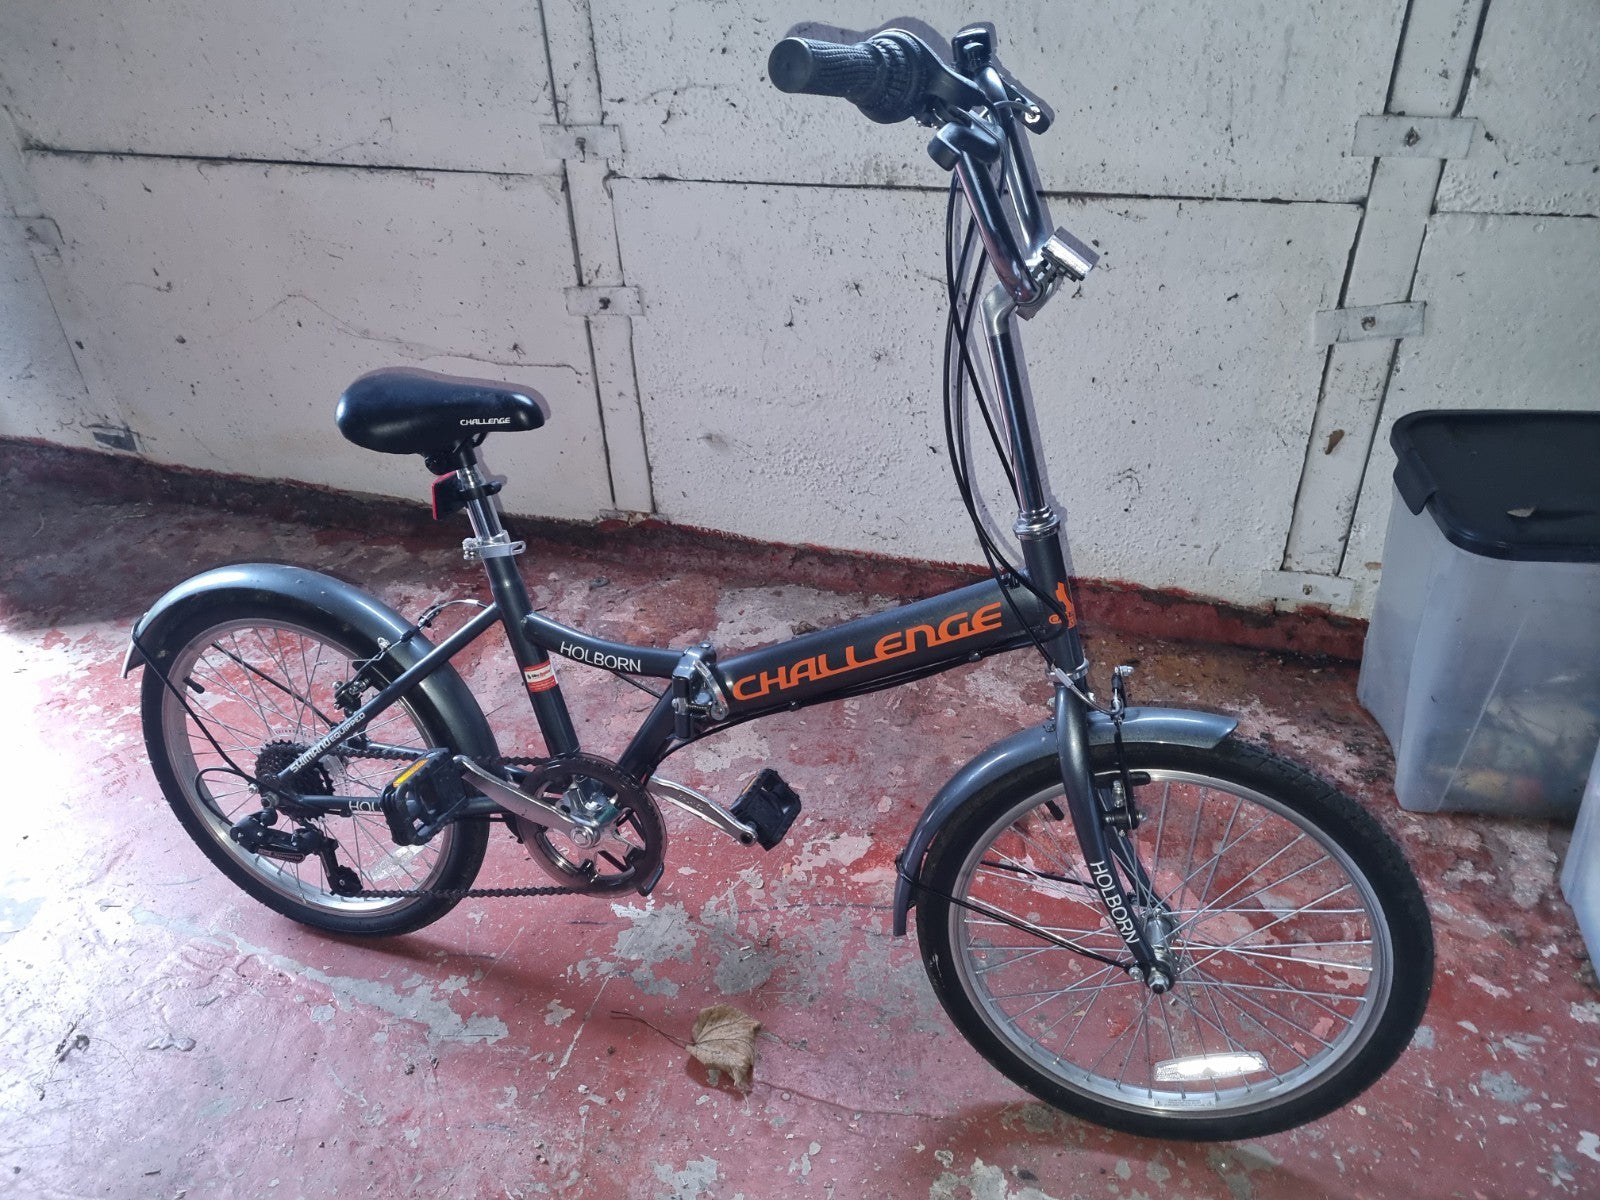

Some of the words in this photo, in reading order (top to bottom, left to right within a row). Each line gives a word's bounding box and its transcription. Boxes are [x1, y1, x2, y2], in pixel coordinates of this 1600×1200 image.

[460, 417, 511, 426] CHALLENGE
[560, 641, 642, 673] HOLBORN
[732, 602, 1002, 701] CHALLENGE
[290, 737, 332, 773] SHIMANO
[330, 712, 366, 743] EQUIPPED
[1090, 860, 1140, 944] HOLBORN
